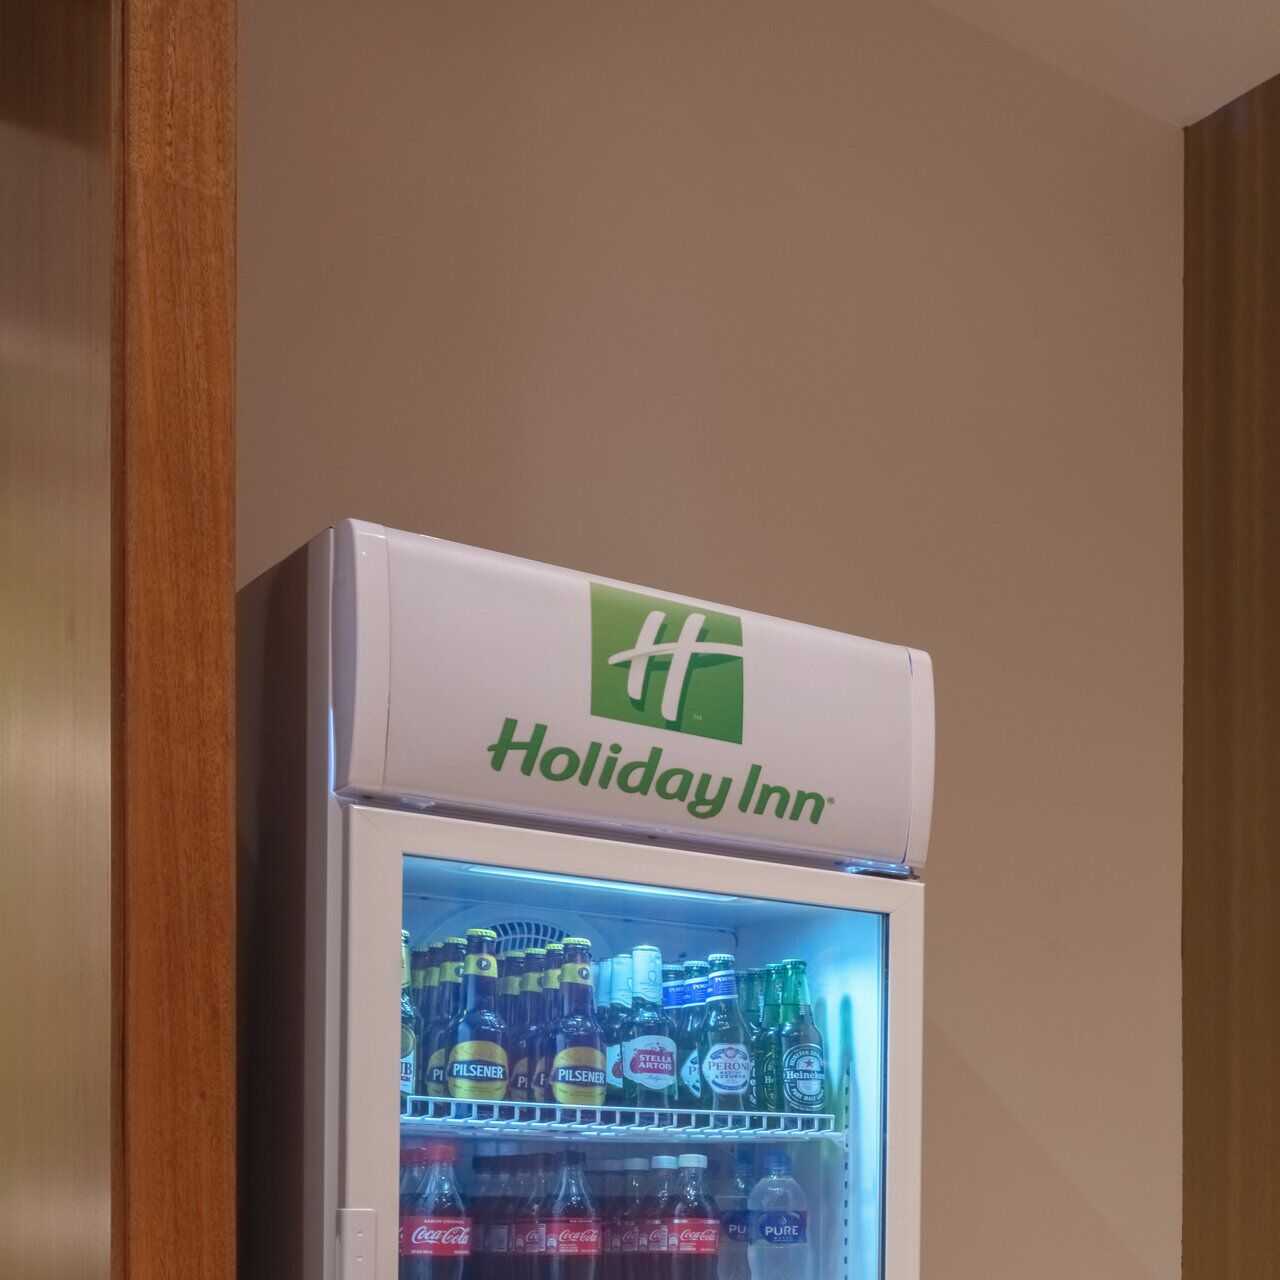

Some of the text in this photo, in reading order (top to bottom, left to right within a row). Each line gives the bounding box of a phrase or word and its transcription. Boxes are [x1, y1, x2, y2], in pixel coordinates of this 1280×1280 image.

[487, 717, 826, 825] Holiday Inn
[639, 1054, 672, 1064] STELLA
[453, 1063, 504, 1079] PILSENER
[638, 1061, 673, 1071] ARTOIS
[558, 1069, 605, 1084] PILSENER
[786, 1070, 825, 1080] Heineke
[411, 1225, 471, 1245] Coca-Cola
[680, 1229, 717, 1241] Coca-Cola
[729, 1224, 746, 1234] PU
[765, 1225, 799, 1236] PURE
[558, 1229, 599, 1242] Coca-Cola
